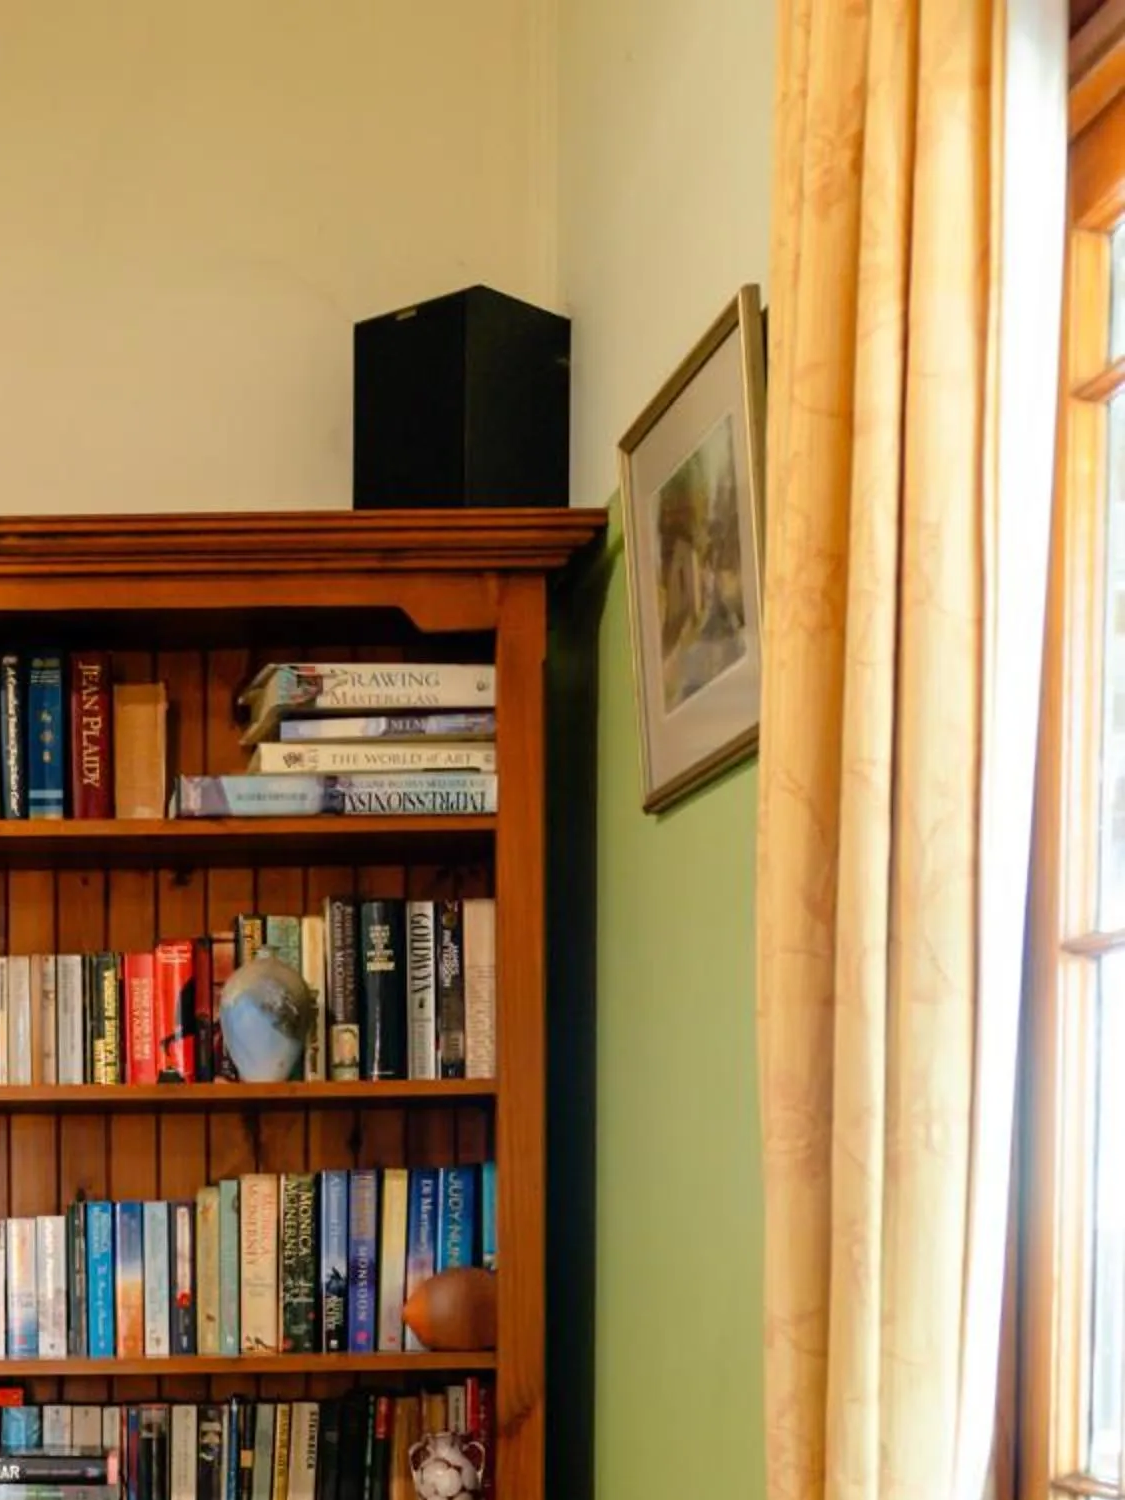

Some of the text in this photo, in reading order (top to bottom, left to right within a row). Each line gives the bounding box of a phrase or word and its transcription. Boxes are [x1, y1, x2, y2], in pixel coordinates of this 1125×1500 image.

[79, 662, 102, 788] JEAN PLAIDY
[364, 753, 421, 766] WORLD
[411, 912, 431, 994] GOLDWYN
[298, 1191, 312, 1257] MONICA
[446, 1172, 463, 1268] JUDY NUN
[356, 1246, 368, 1322] MONSOON
[306, 1410, 318, 1470] STEINBECK
